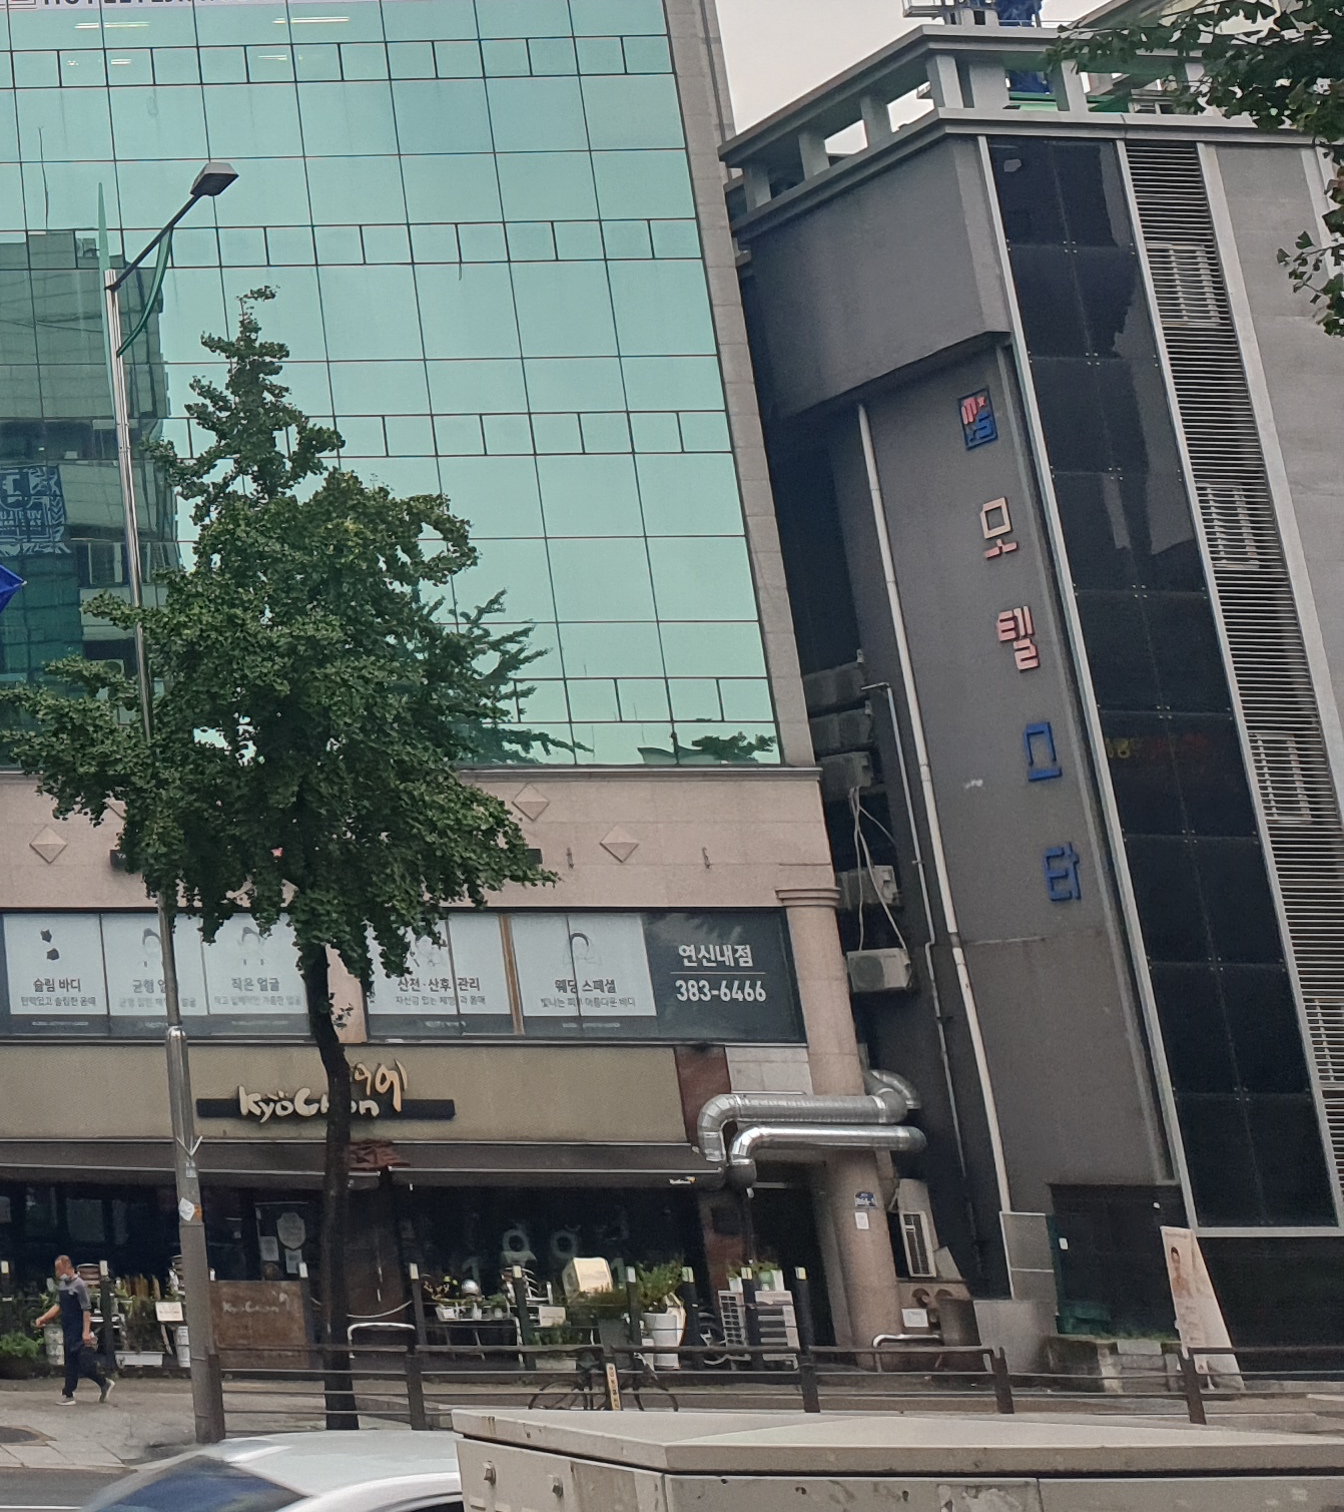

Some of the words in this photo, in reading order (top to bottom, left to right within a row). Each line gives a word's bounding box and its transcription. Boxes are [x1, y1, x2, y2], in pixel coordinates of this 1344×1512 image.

[678, 943, 754, 969] 연신내점
[58, 977, 82, 993] 바디
[676, 978, 767, 1004] 383-6466
